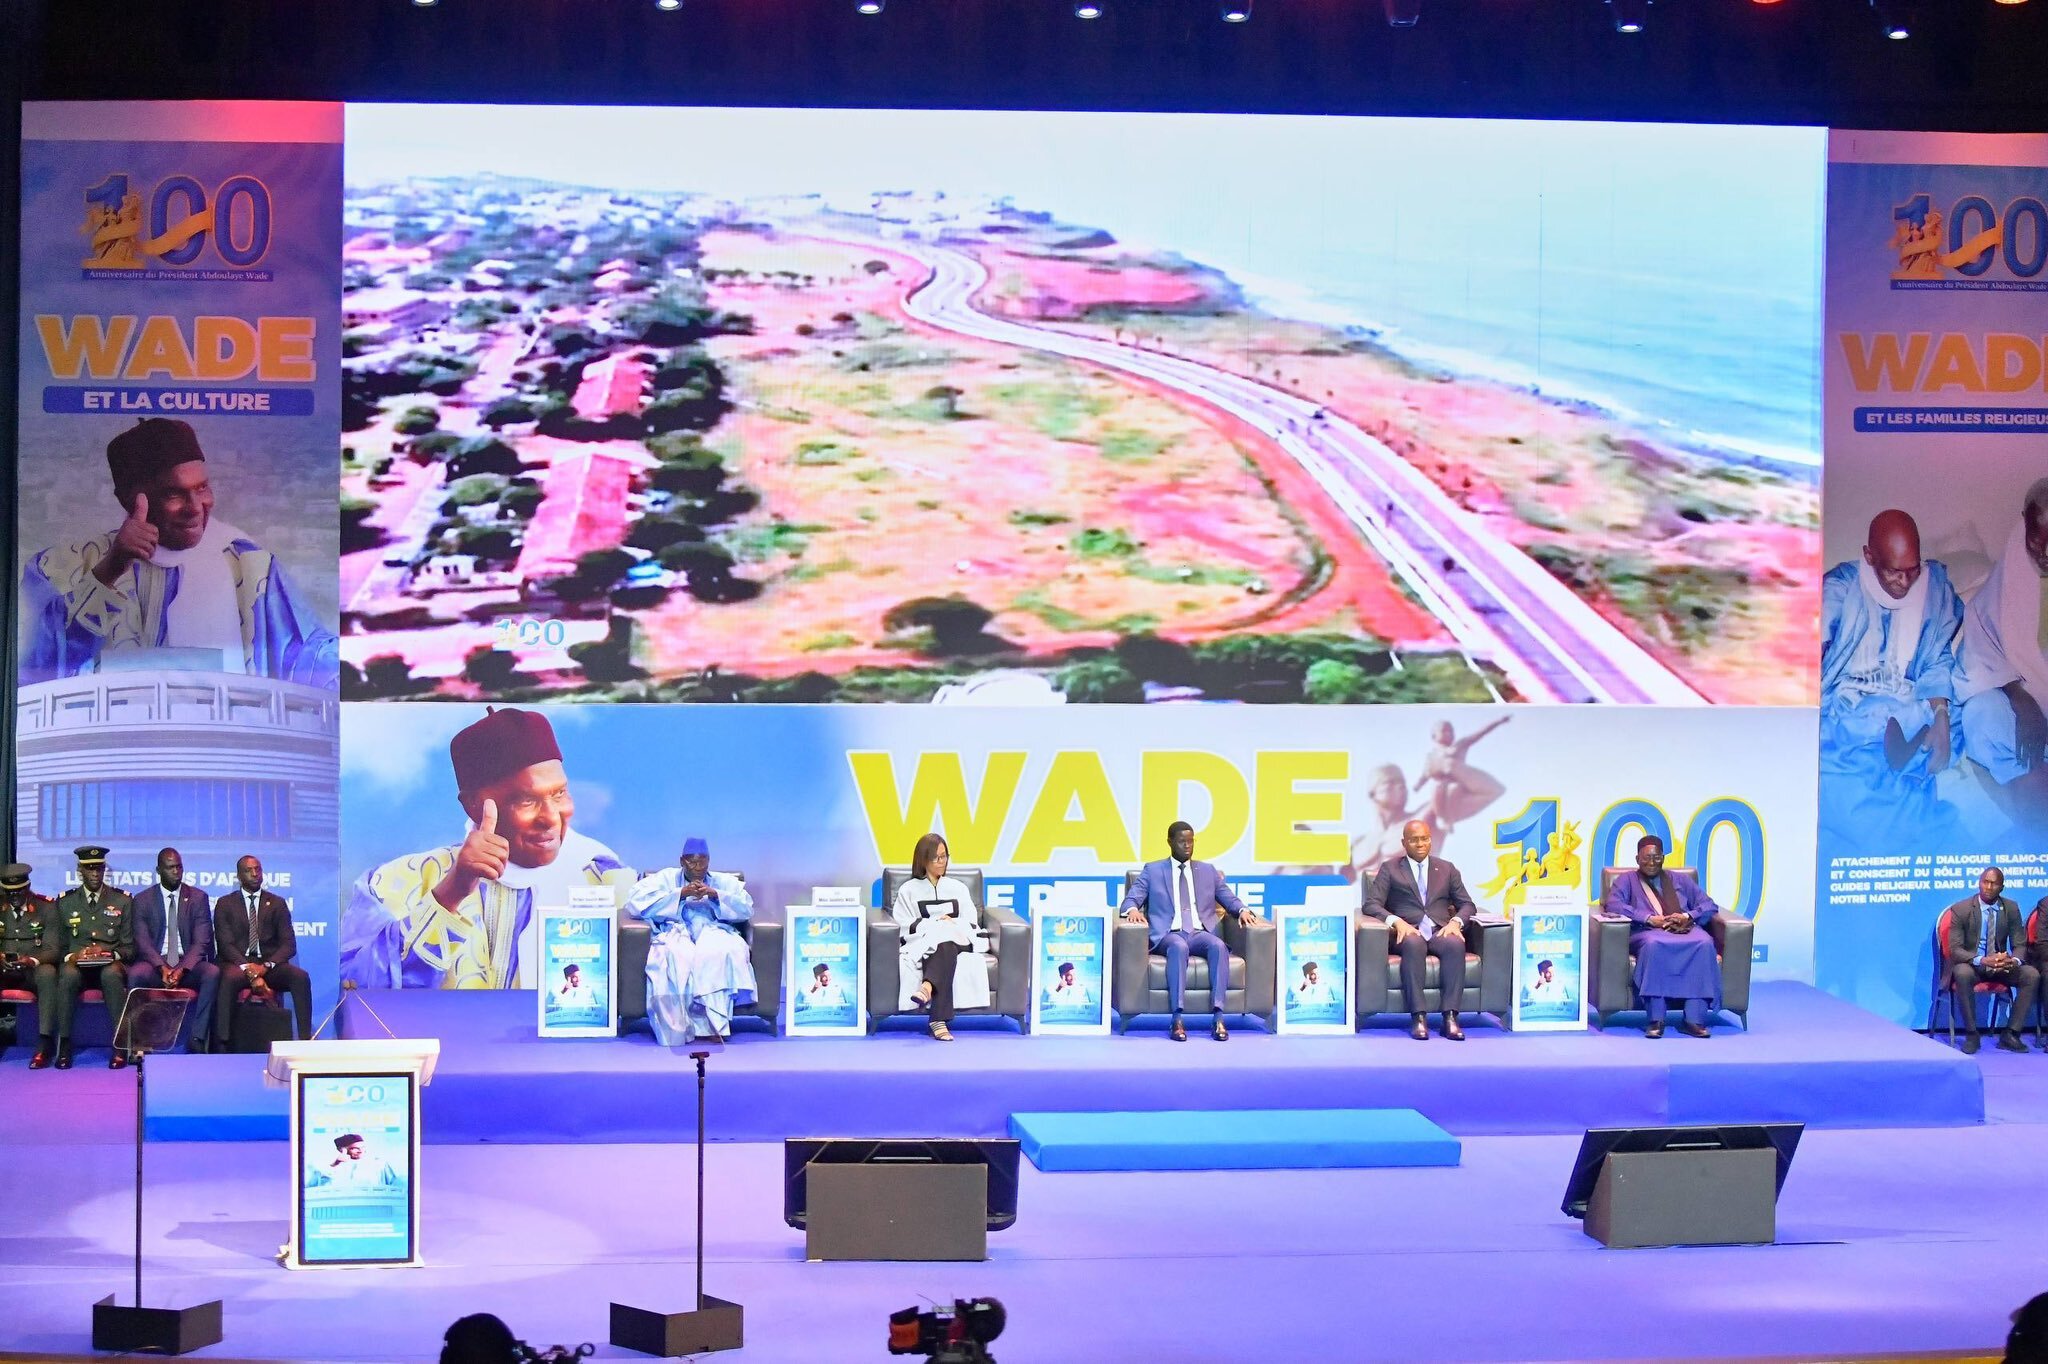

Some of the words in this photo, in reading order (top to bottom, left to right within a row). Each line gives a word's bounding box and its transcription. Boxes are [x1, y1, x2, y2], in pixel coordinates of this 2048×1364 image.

[84, 173, 272, 267] 100
[1892, 193, 2048, 278] 100
[89, 271, 143, 279] Anniversaire
[145, 271, 157, 279] du
[201, 272, 244, 281] Abdoulaye
[1896, 281, 1943, 289] Anniversaire
[1991, 282, 2027, 291] Abdoulaye
[2028, 283, 2047, 291] Wade
[34, 315, 316, 381] WADE
[1839, 332, 2048, 393] WAD
[83, 391, 115, 409] ET
[121, 391, 152, 410] LA
[159, 392, 270, 411] CULTURE
[1867, 413, 1884, 424] ET
[1887, 413, 1913, 425] LES
[1916, 413, 1982, 425] FAMILLES
[847, 749, 1351, 866] WADE
[1831, 856, 1911, 867] ATTACHEMENT
[1915, 855, 1932, 865] AU
[1936, 854, 1991, 865] DIALOGUE
[1995, 853, 2048, 864] ISLAMO-C
[1830, 870, 1845, 880] ET
[1848, 868, 1910, 879] CONSCIENT
[1914, 868, 1930, 878] DU
[1933, 865, 1962, 877] RÔLE
[1830, 882, 1870, 892] GUIDES
[1874, 880, 1931, 891] RELIGIEUX
[1934, 880, 1965, 889] DANS
[1830, 894, 1867, 904] NOTRE
[1869, 893, 1911, 903] NATION
[292, 921, 327, 936] ENT
